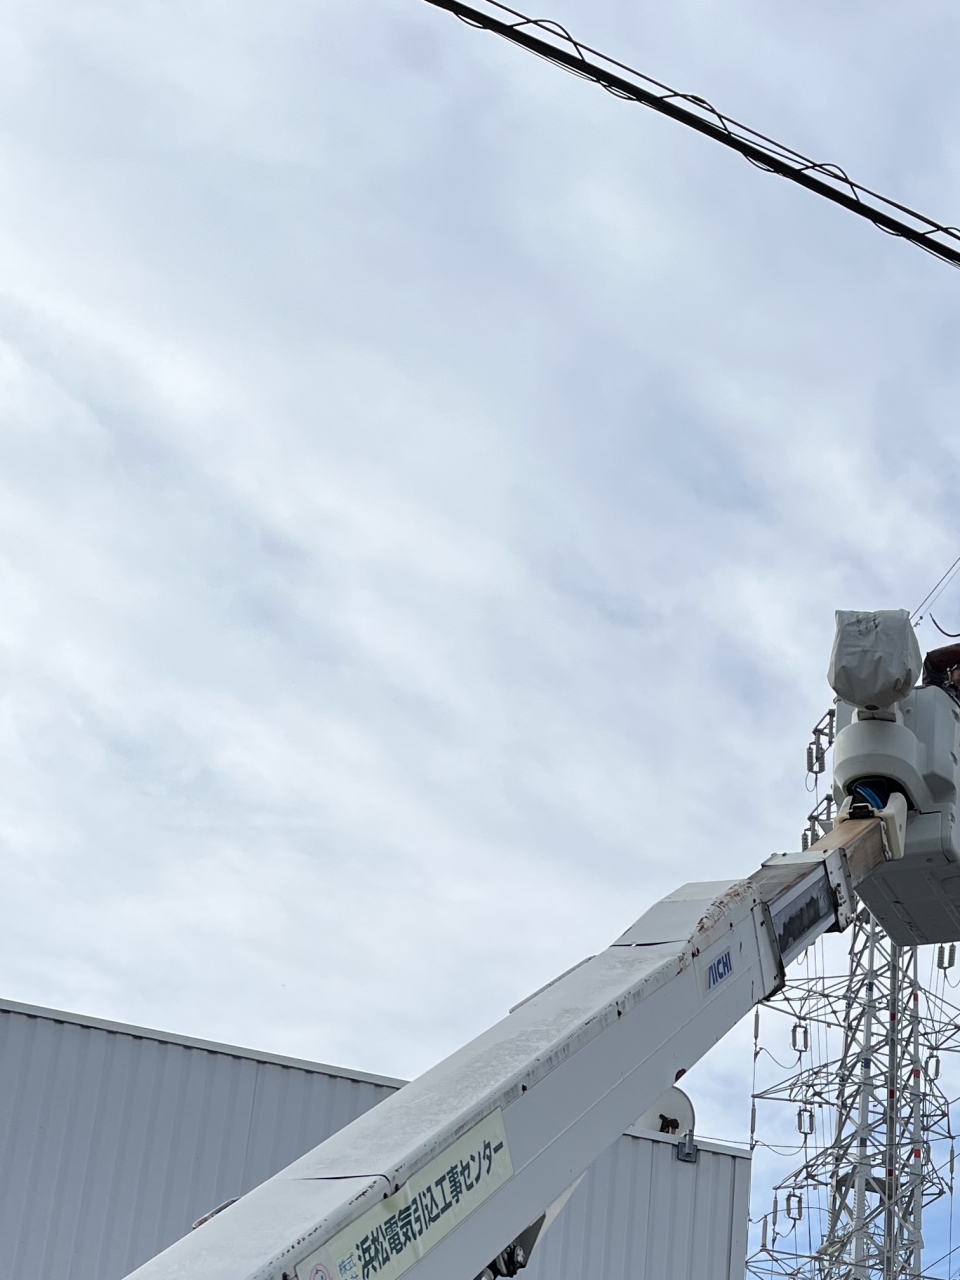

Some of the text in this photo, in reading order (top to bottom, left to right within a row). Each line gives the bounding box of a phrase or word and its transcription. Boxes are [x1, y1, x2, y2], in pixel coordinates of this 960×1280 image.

[708, 951, 733, 990] AICHI
[355, 1140, 504, 1280] 浜松電気引込工事センター
[338, 1252, 356, 1277] 株式
